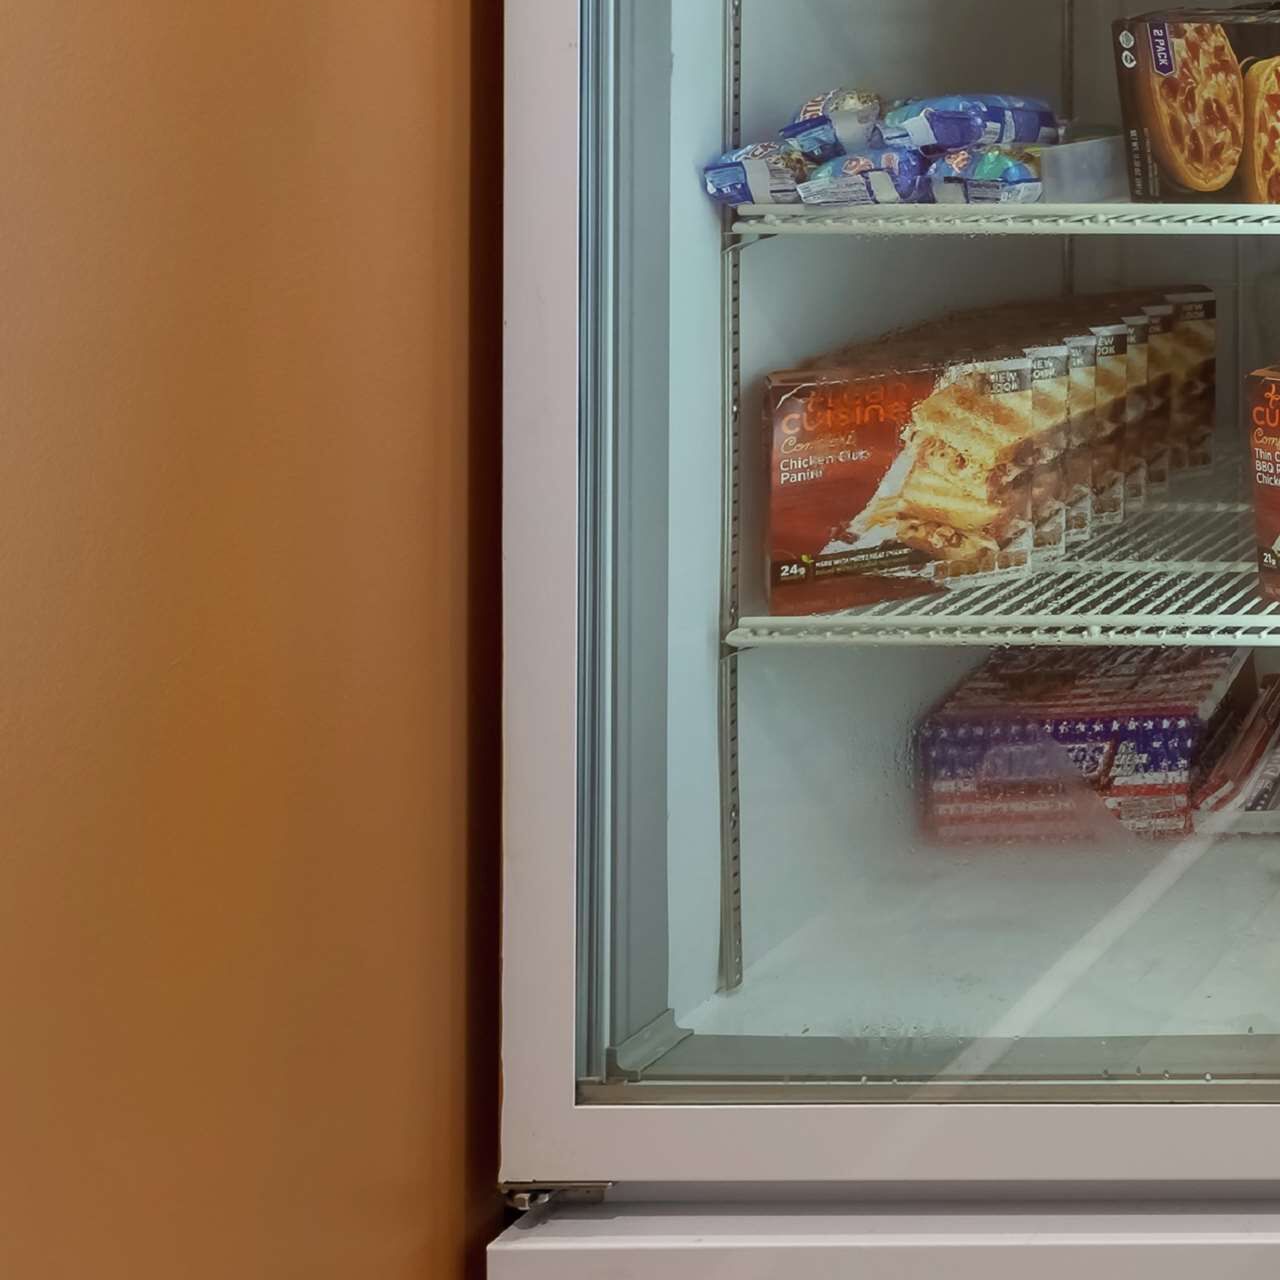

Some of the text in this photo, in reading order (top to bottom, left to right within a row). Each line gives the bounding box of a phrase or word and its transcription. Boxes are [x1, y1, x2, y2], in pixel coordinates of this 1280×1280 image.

[1154, 39, 1169, 67] PACK
[1096, 346, 1116, 356] OOK
[781, 431, 857, 455] Comt
[1255, 448, 1273, 460] Thin
[780, 454, 834, 471] Chicken
[1256, 460, 1274, 474] BBQ
[780, 469, 823, 485] Panini
